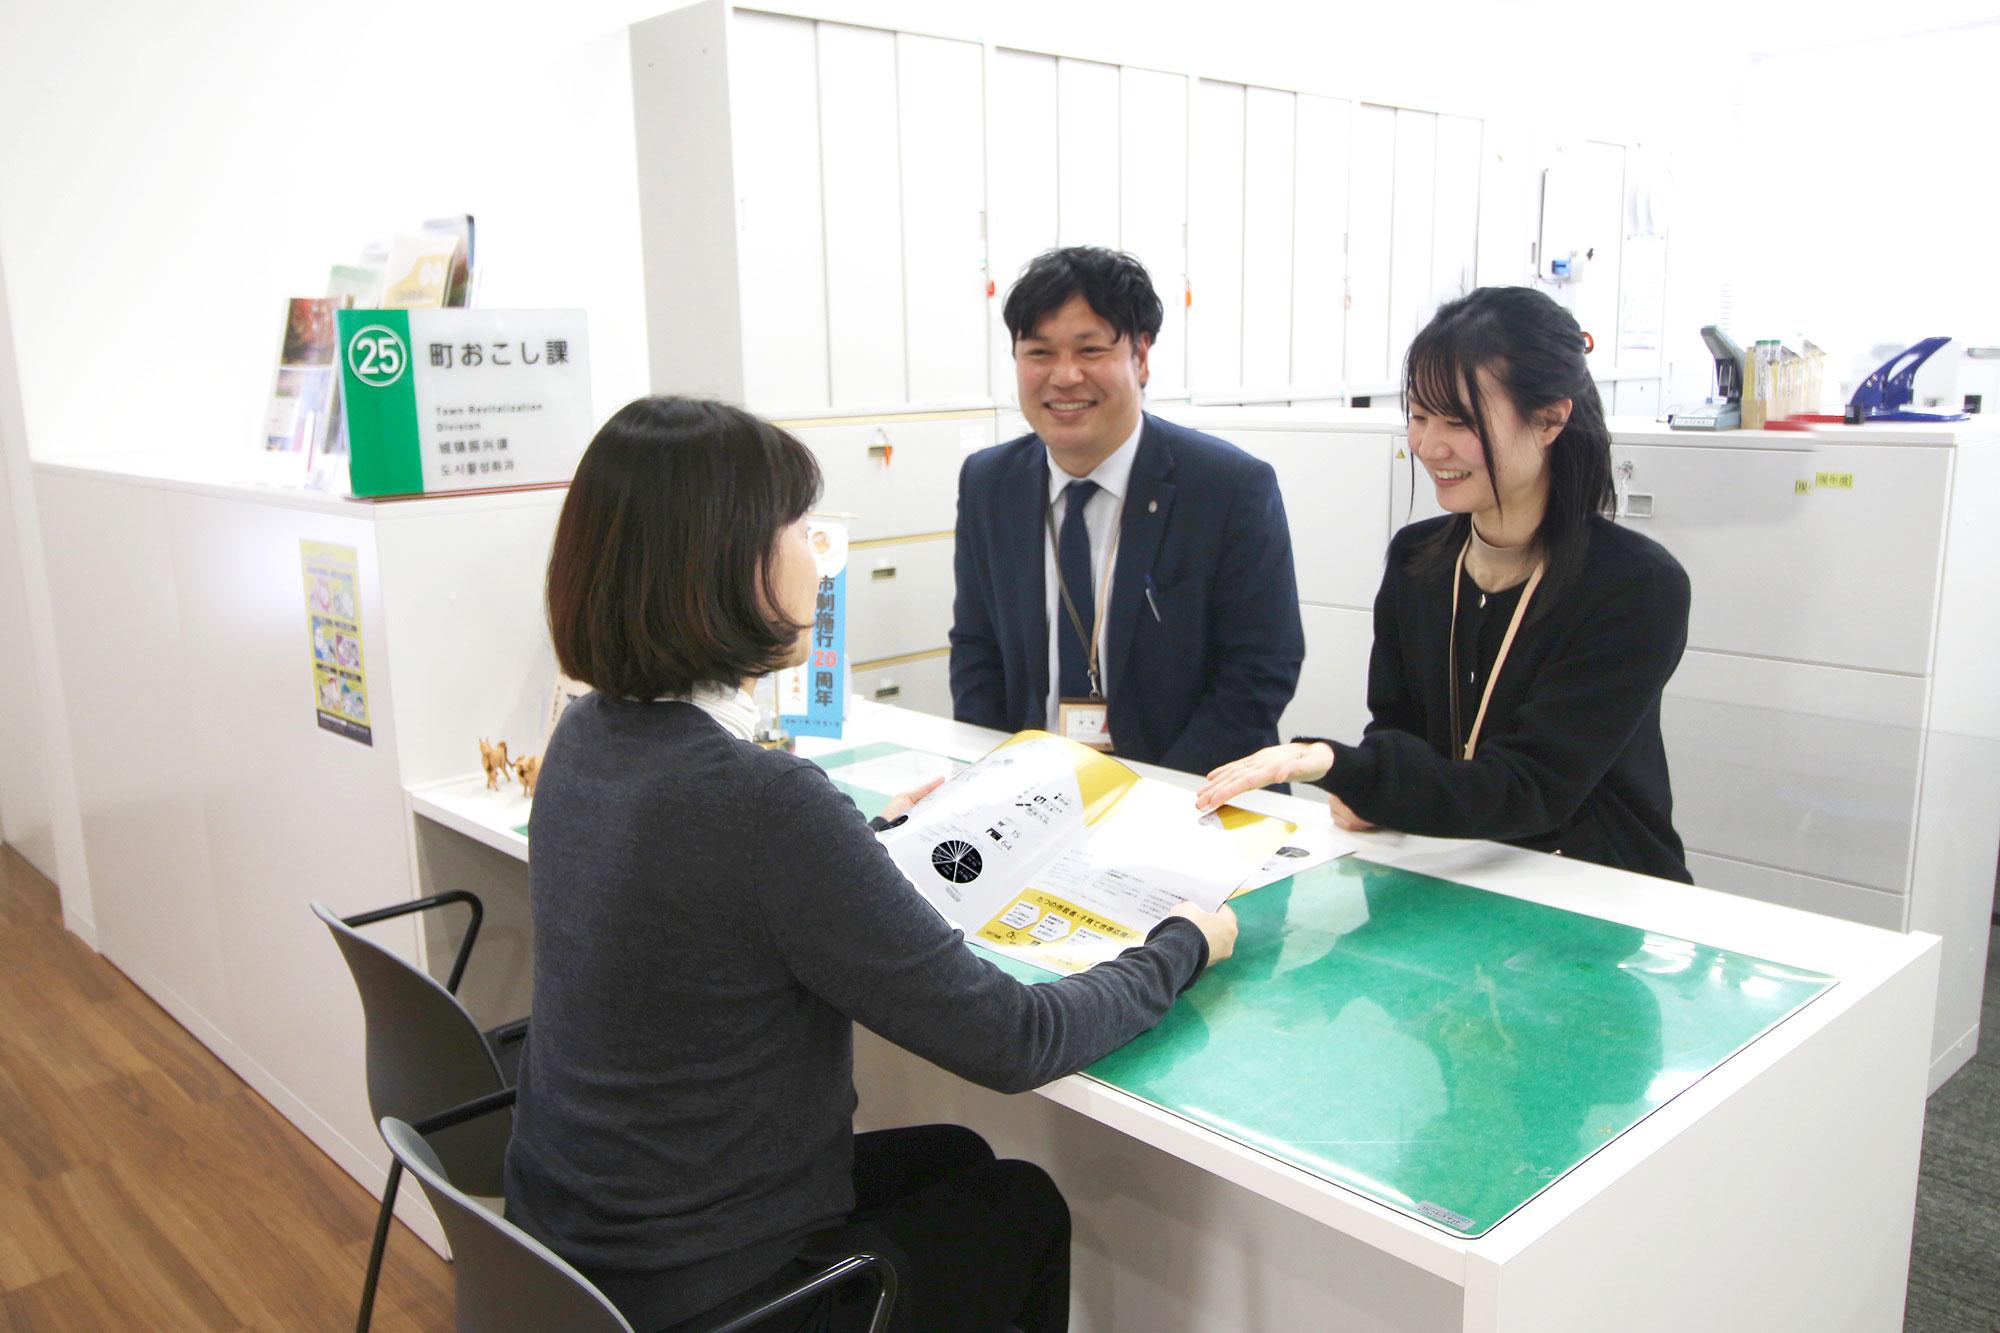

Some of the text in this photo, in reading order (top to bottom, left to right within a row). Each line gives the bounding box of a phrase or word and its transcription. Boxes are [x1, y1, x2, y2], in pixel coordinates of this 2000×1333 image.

[357, 337, 399, 375] 25
[430, 340, 569, 369] 町おこし課
[436, 403, 543, 416] Town Revitalization
[436, 422, 481, 433] Division
